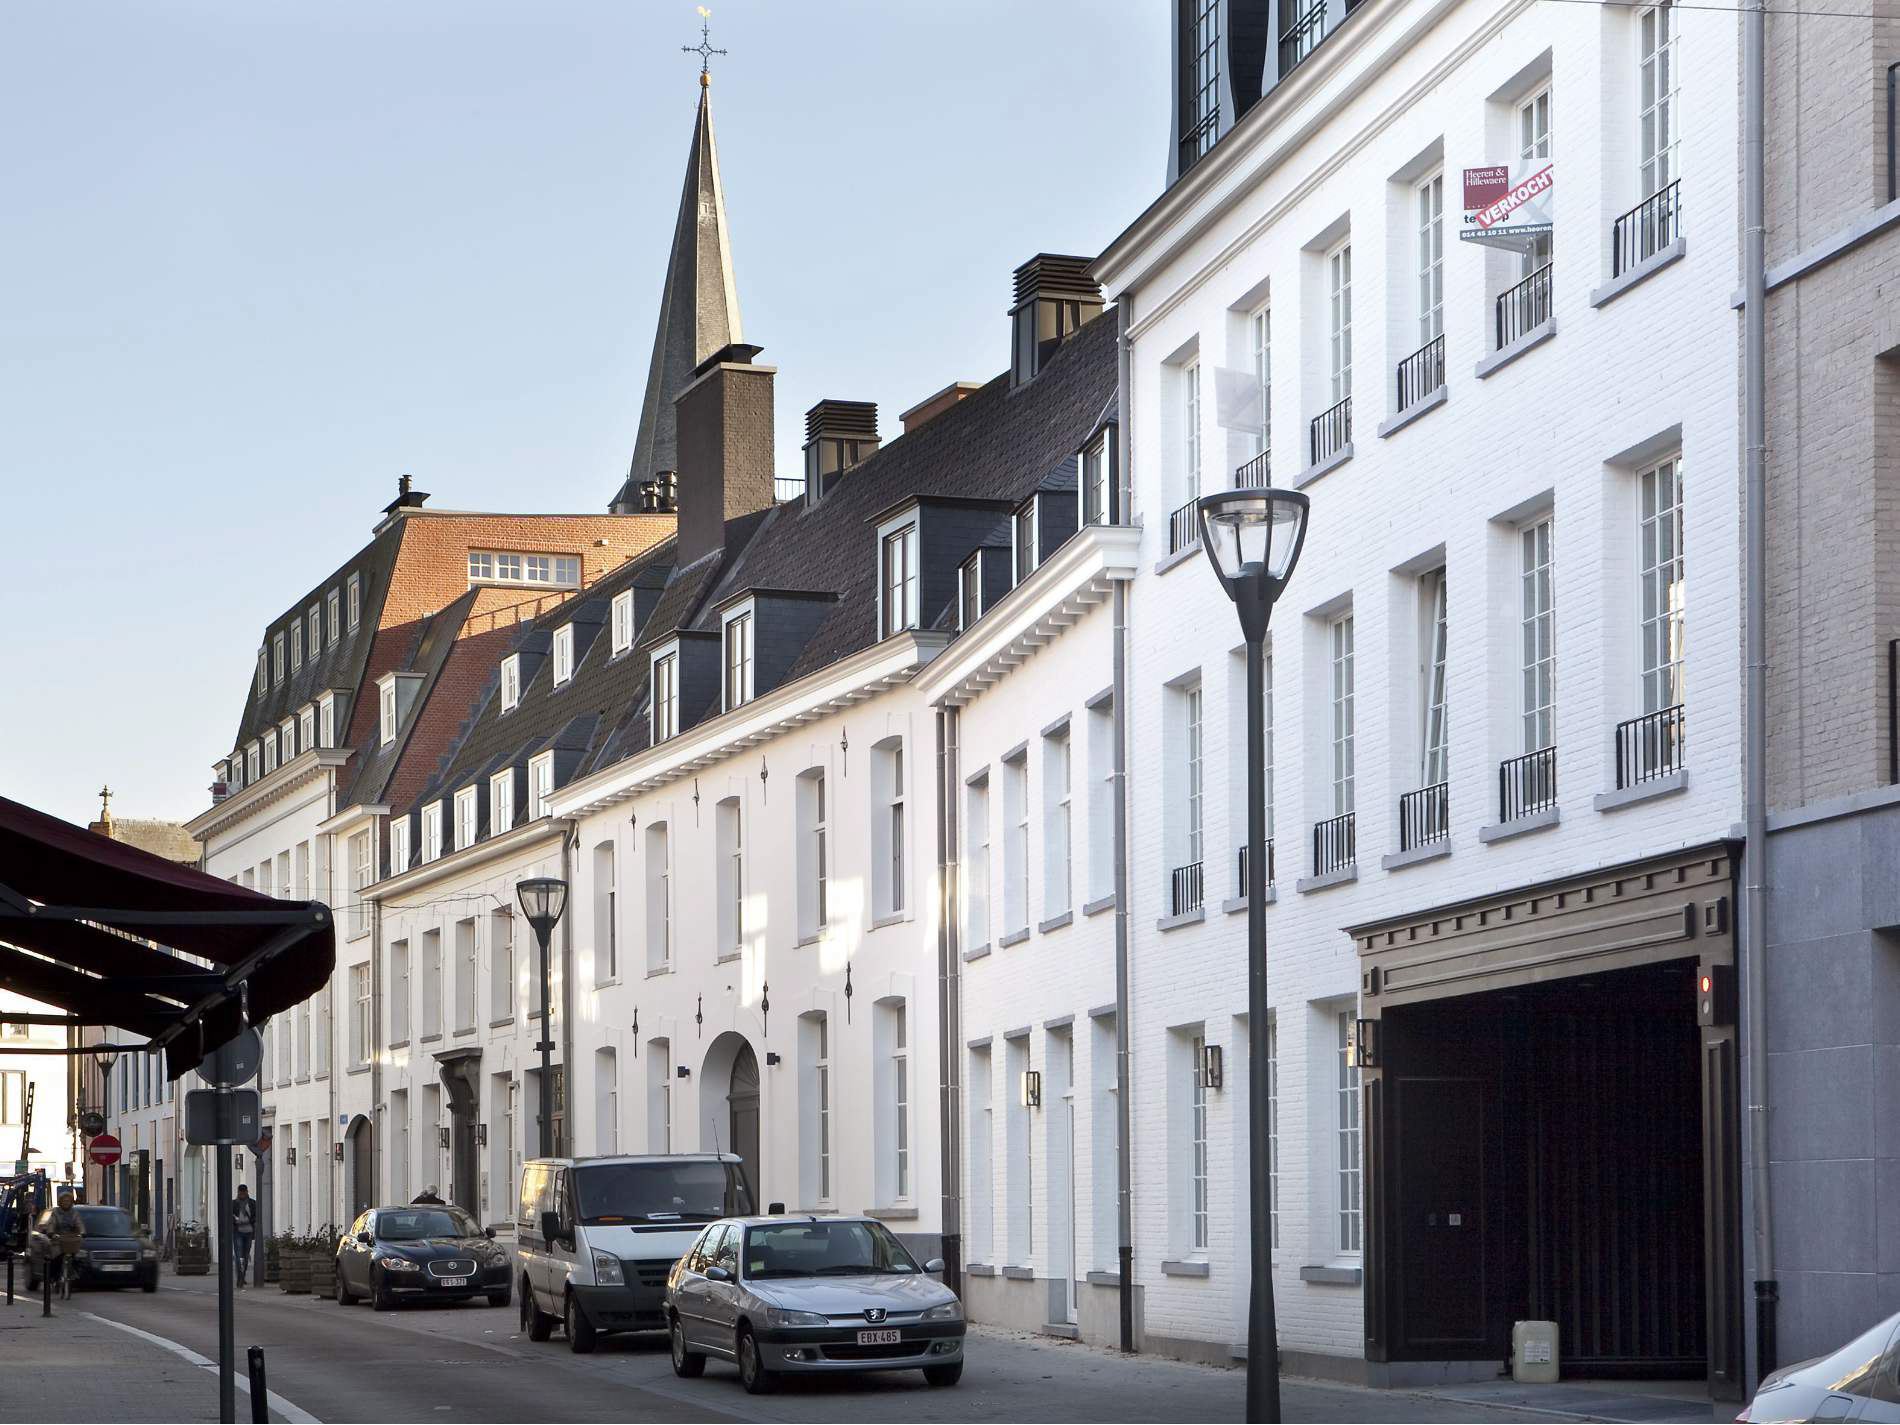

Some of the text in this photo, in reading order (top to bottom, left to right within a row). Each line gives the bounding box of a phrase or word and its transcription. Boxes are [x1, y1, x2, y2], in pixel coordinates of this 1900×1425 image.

[1466, 168, 1505, 179] Heeren &
[1466, 177, 1507, 186] Hillewaere
[1464, 214, 1476, 223] te
